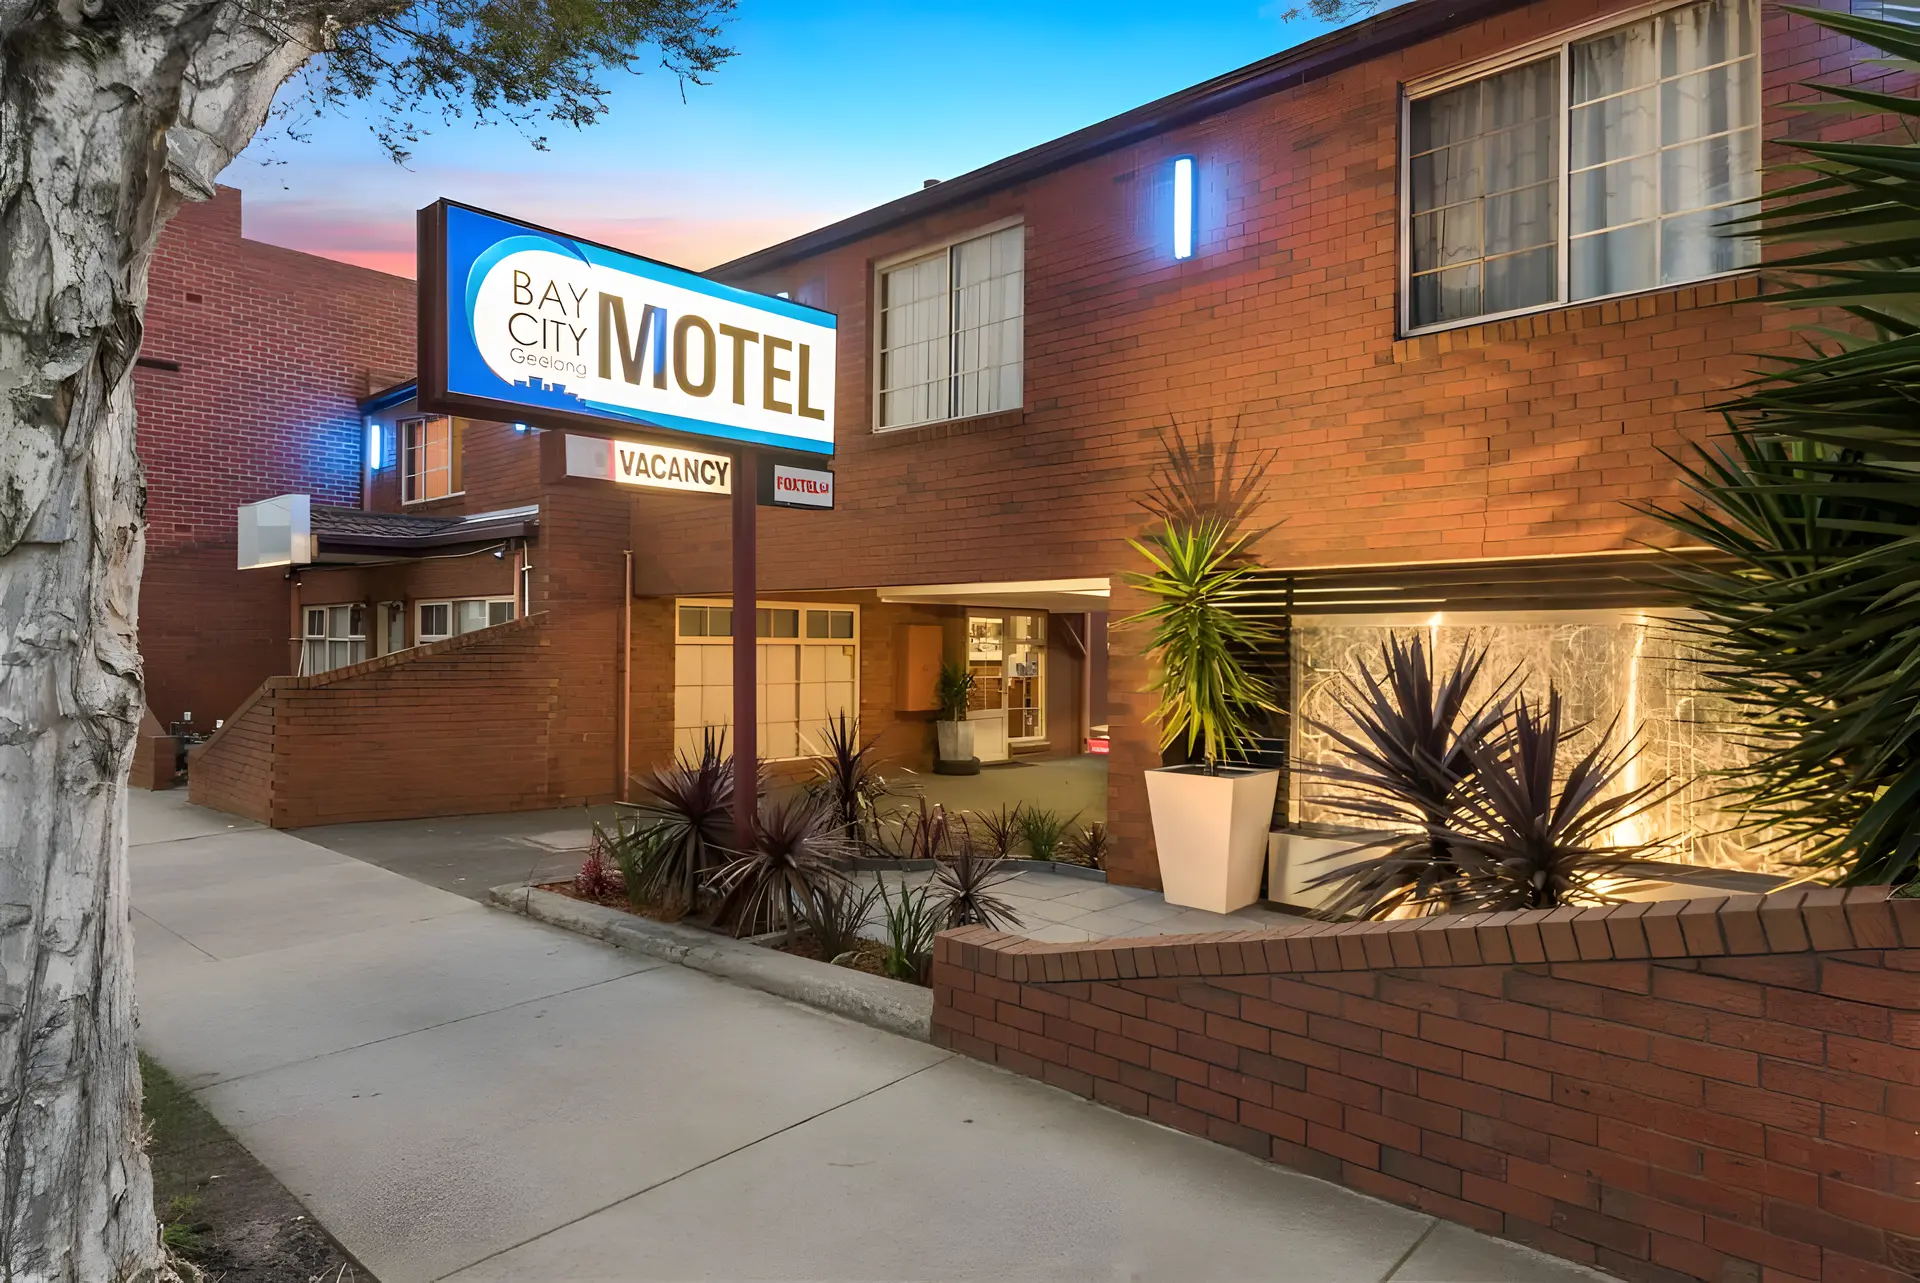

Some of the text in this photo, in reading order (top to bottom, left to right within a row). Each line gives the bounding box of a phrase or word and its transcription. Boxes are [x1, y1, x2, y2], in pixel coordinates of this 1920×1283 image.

[513, 269, 589, 318] BAY
[508, 312, 588, 356] CITY
[598, 291, 825, 421] MOTEL
[510, 347, 587, 379] Geelong
[619, 450, 729, 486] VACANCY
